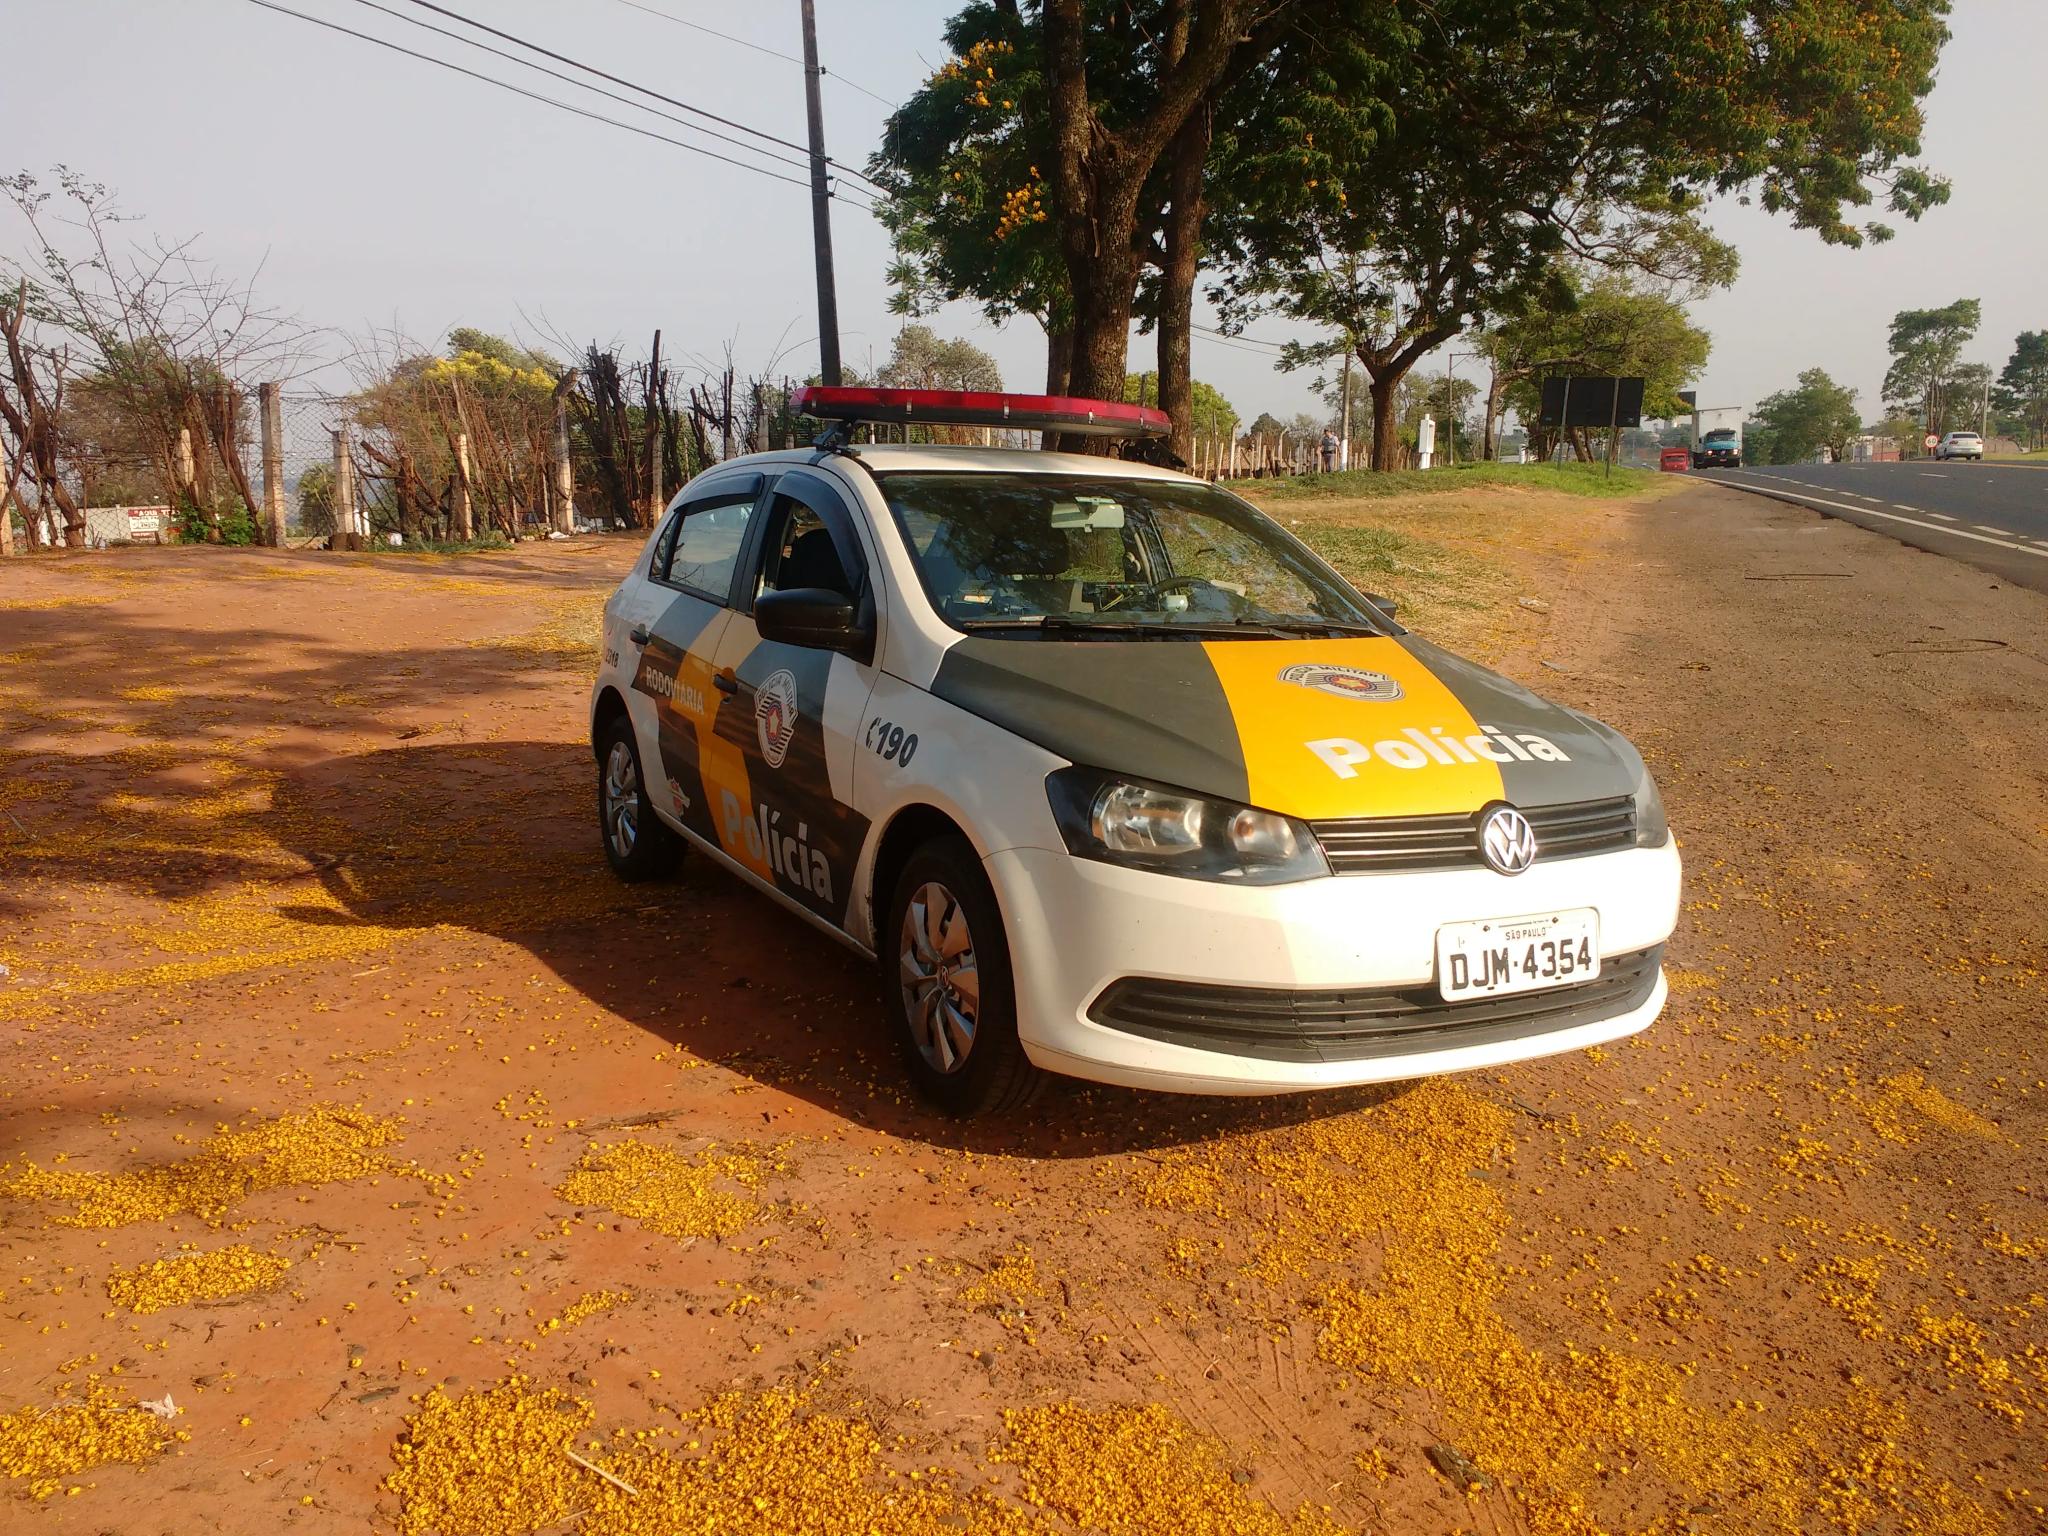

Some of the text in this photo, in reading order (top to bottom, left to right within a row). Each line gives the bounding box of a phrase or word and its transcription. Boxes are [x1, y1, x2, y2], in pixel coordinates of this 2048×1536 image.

[876, 722, 919, 768] 190
[1304, 725, 1572, 779] Polícia
[721, 788, 834, 904] Polícia
[1505, 926, 1546, 941] SÃO PAULO
